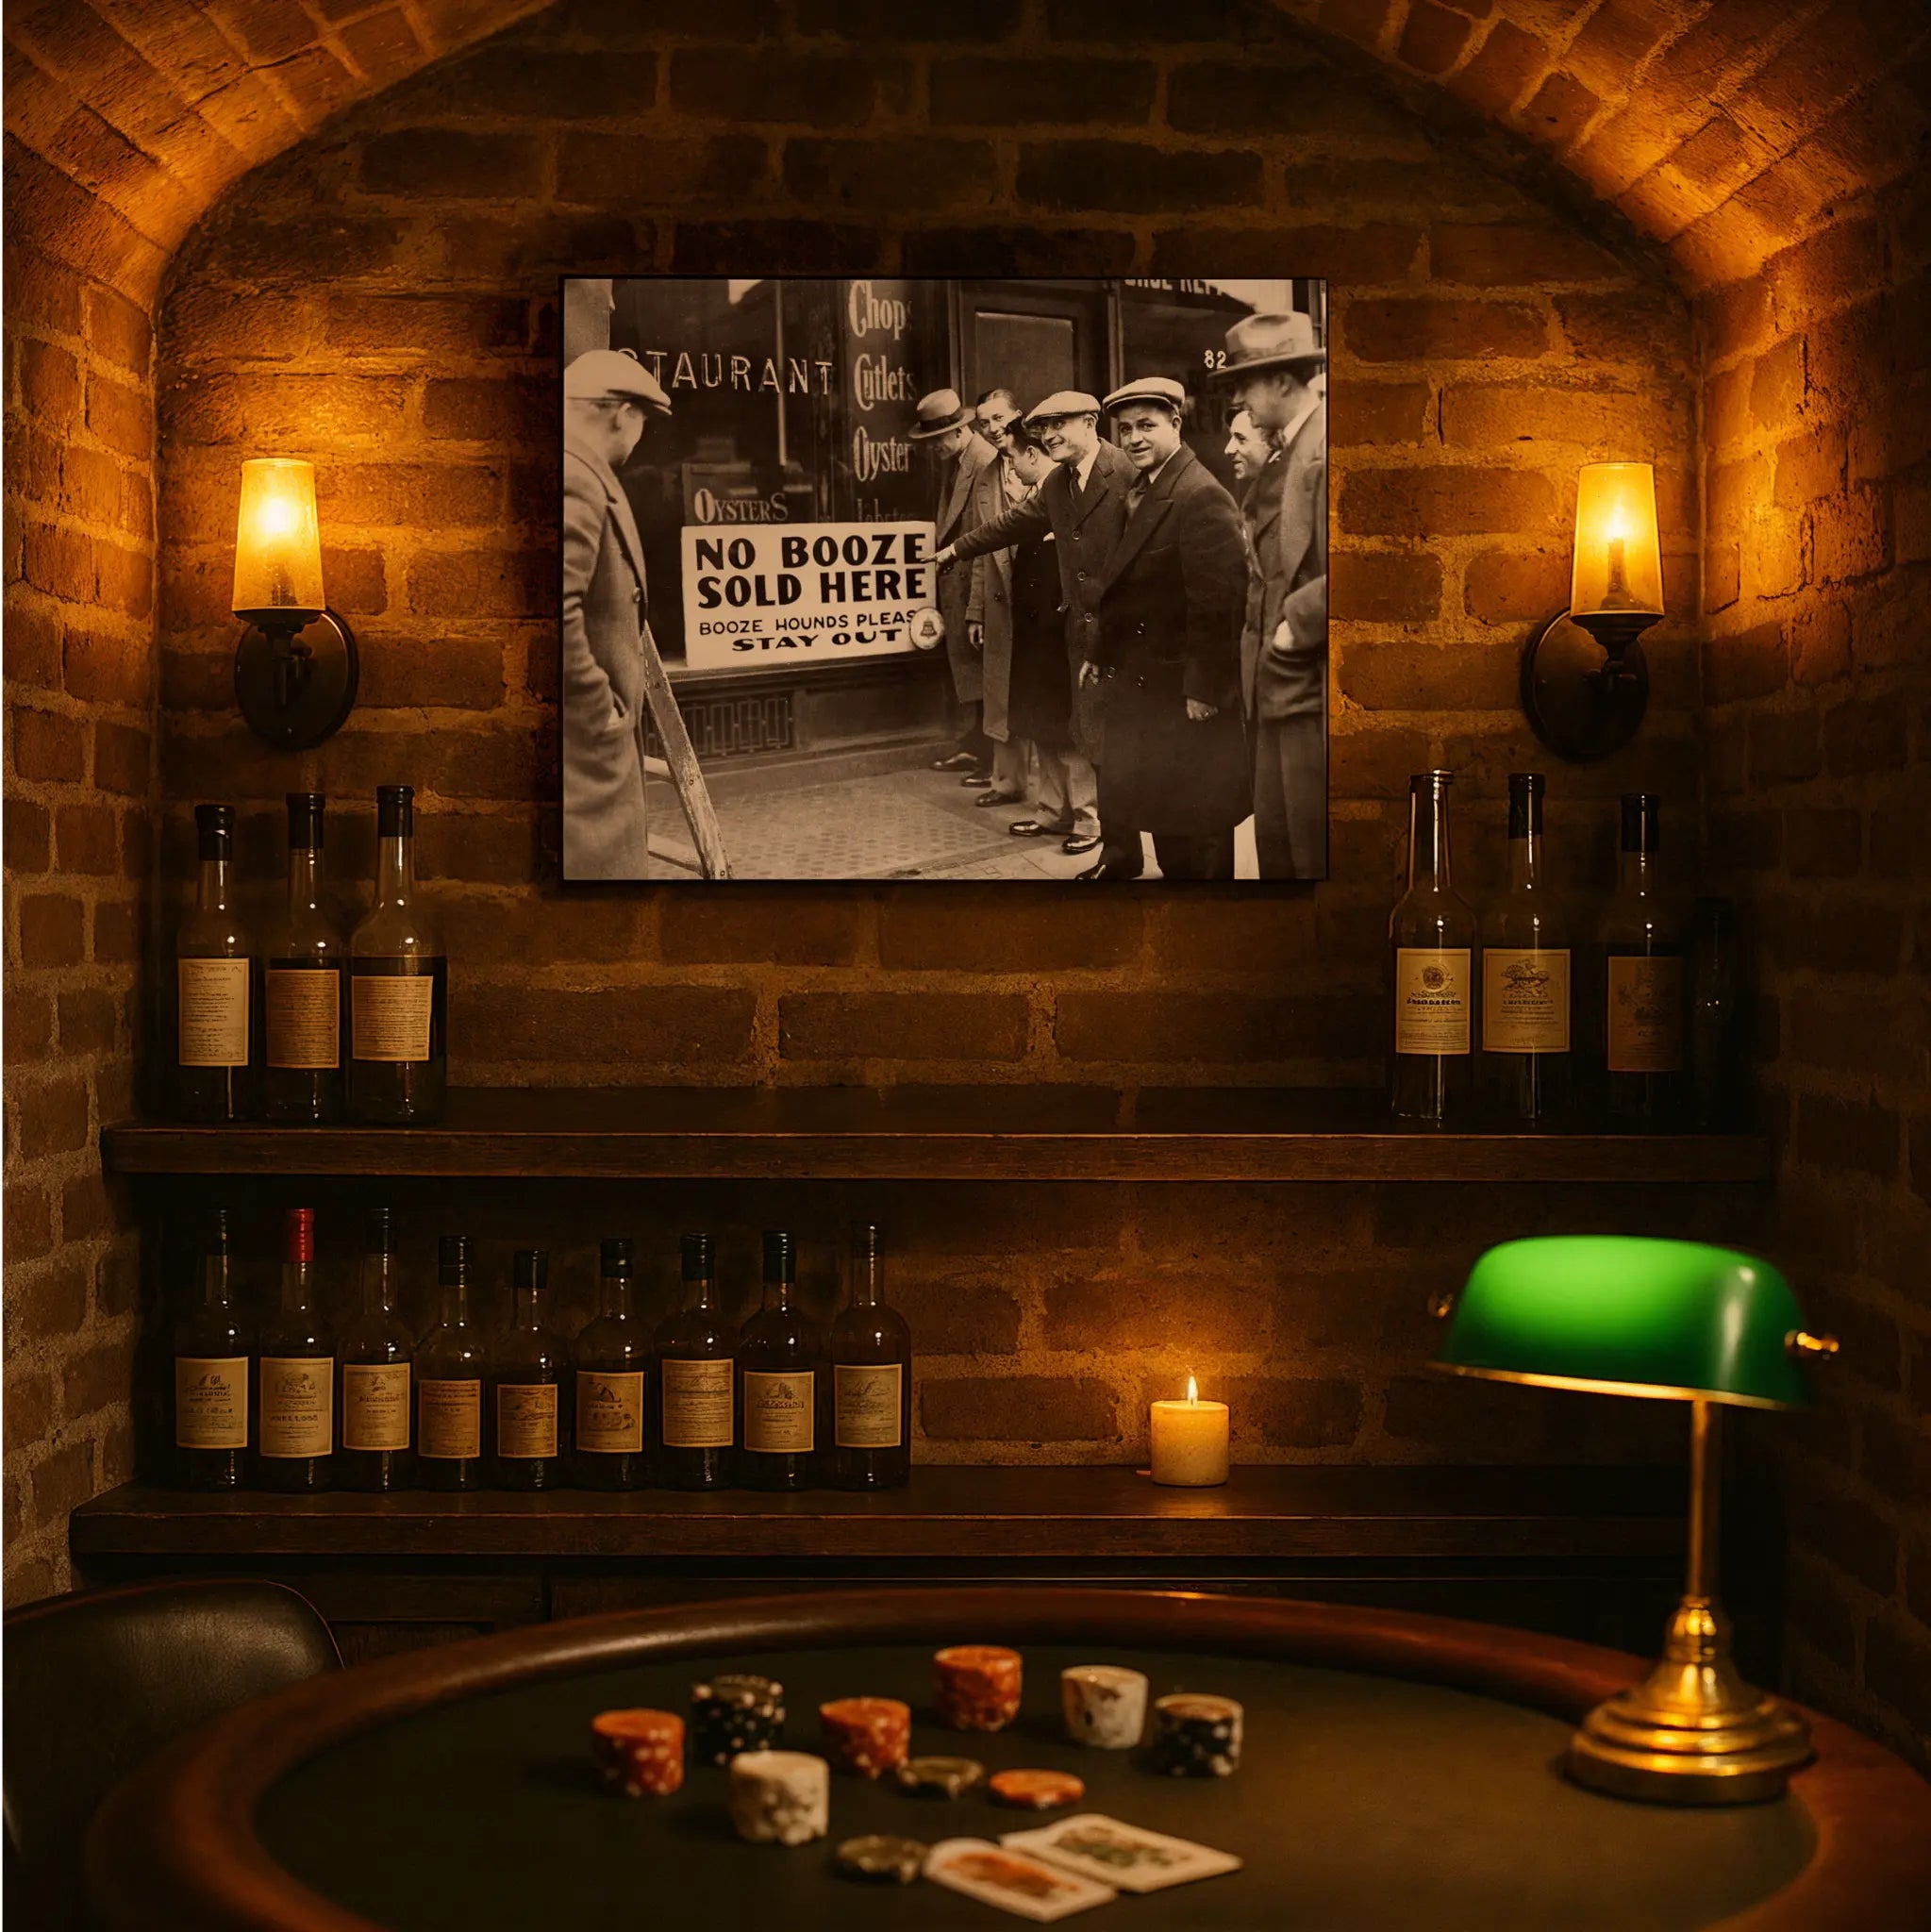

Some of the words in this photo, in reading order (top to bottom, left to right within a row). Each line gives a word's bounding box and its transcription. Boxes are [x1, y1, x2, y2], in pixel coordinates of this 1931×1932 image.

[1204, 349, 1226, 370] 82
[694, 488, 789, 524] OYSTERS
[695, 538, 757, 571] NO
[781, 533, 926, 569] BOOZE
[697, 574, 802, 608] SOLD
[820, 568, 926, 604] HERE
[699, 619, 763, 636] BOOZE
[775, 614, 849, 632] HOUNDS
[732, 634, 819, 652] STAY
[831, 628, 902, 646] OUT
